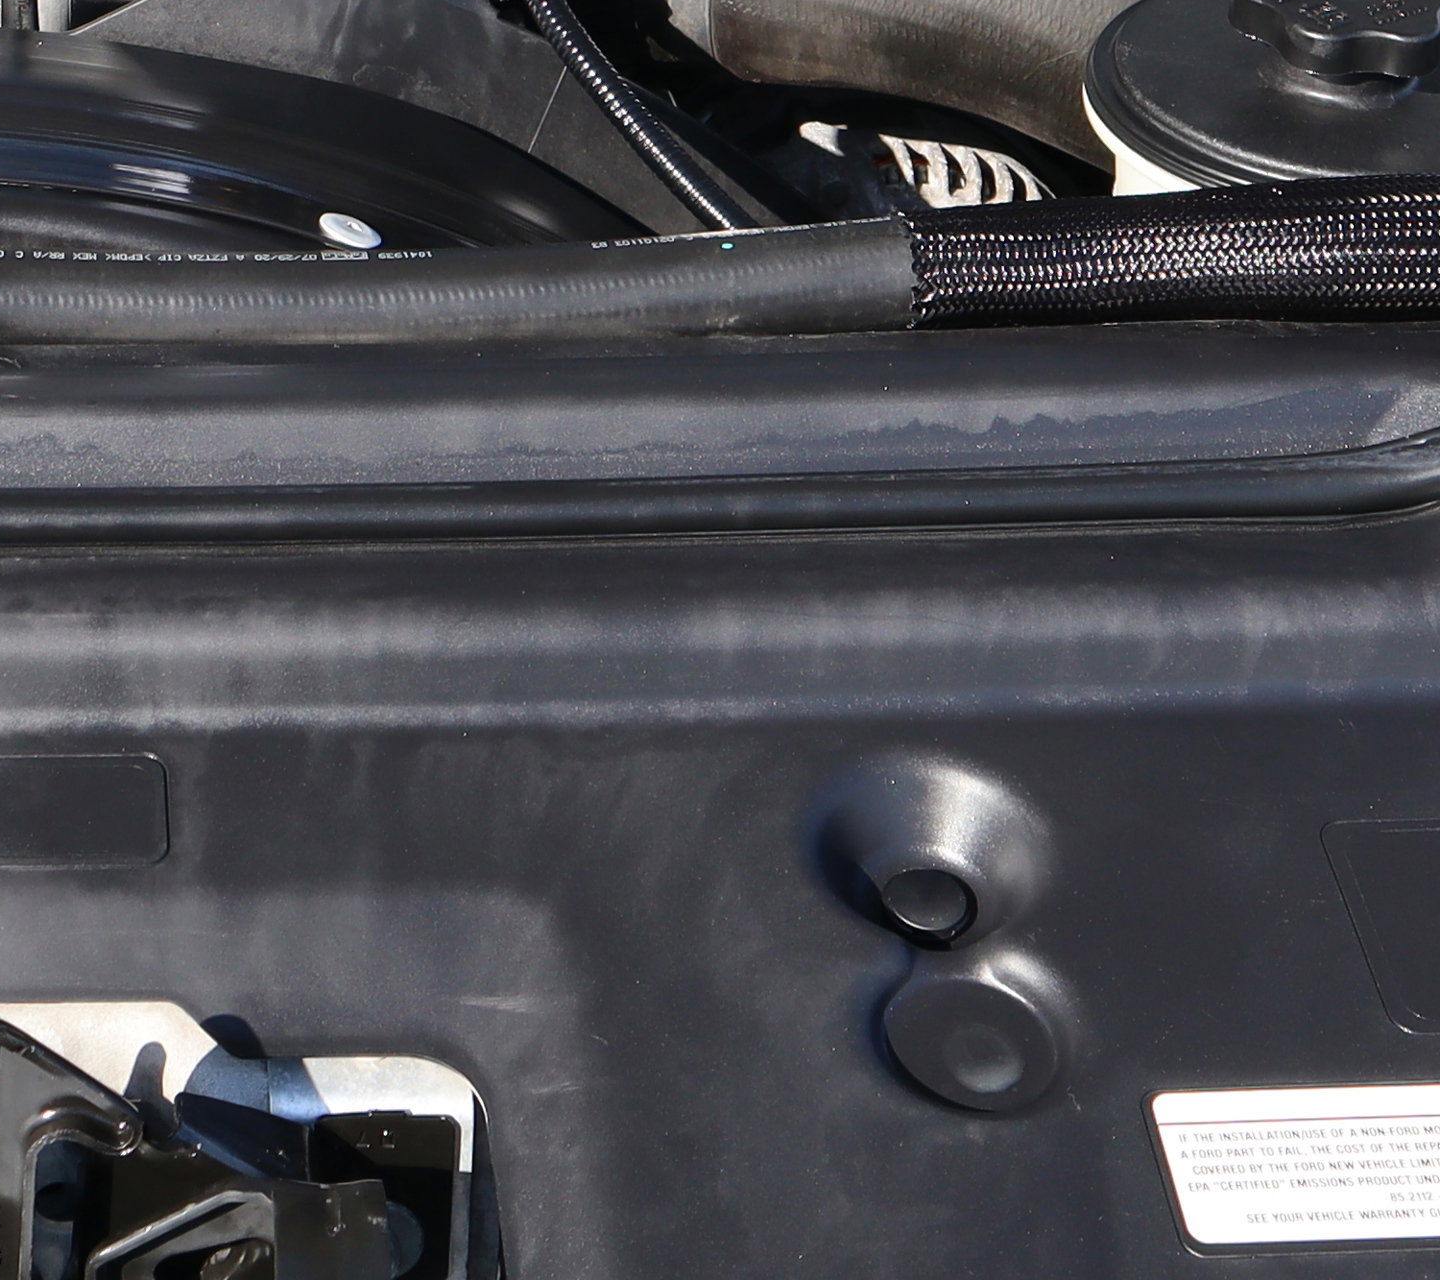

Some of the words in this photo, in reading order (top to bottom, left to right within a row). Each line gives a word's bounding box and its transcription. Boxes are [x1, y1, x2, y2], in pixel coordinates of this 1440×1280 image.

[73, 251, 97, 261] MEX
[1177, 1133, 1187, 1143] IF
[1193, 1132, 1214, 1142] THE
[1219, 1129, 1325, 1141] INSTALLATION/USE
[1330, 1128, 1344, 1138] OF
[1350, 1128, 1358, 1137] A
[1180, 1150, 1189, 1159] A
[1191, 1148, 1223, 1159] FORD
[1226, 1147, 1254, 1157] PART
[1259, 1146, 1275, 1157] TO
[1310, 1144, 1331, 1154] THE
[1335, 1143, 1365, 1154] COST
[1369, 1143, 1383, 1153] OF
[1388, 1142, 1410, 1152] THE
[1192, 1164, 1246, 1175] COVERED
[1248, 1163, 1263, 1173] BY
[1268, 1162, 1289, 1172] THE
[1293, 1161, 1325, 1171] FORD
[1328, 1161, 1354, 1170] NEW
[1358, 1159, 1405, 1169] VEHICLE
[1187, 1182, 1210, 1192] EPA
[1289, 1177, 1354, 1188] EMISSIONS
[1357, 1175, 1411, 1186] PRODUCT
[1246, 1213, 1267, 1224] SEE
[1271, 1212, 1304, 1223] YOUR
[1306, 1210, 1354, 1221] VEHICLE
[1358, 1208, 1424, 1219] WARRANTY
